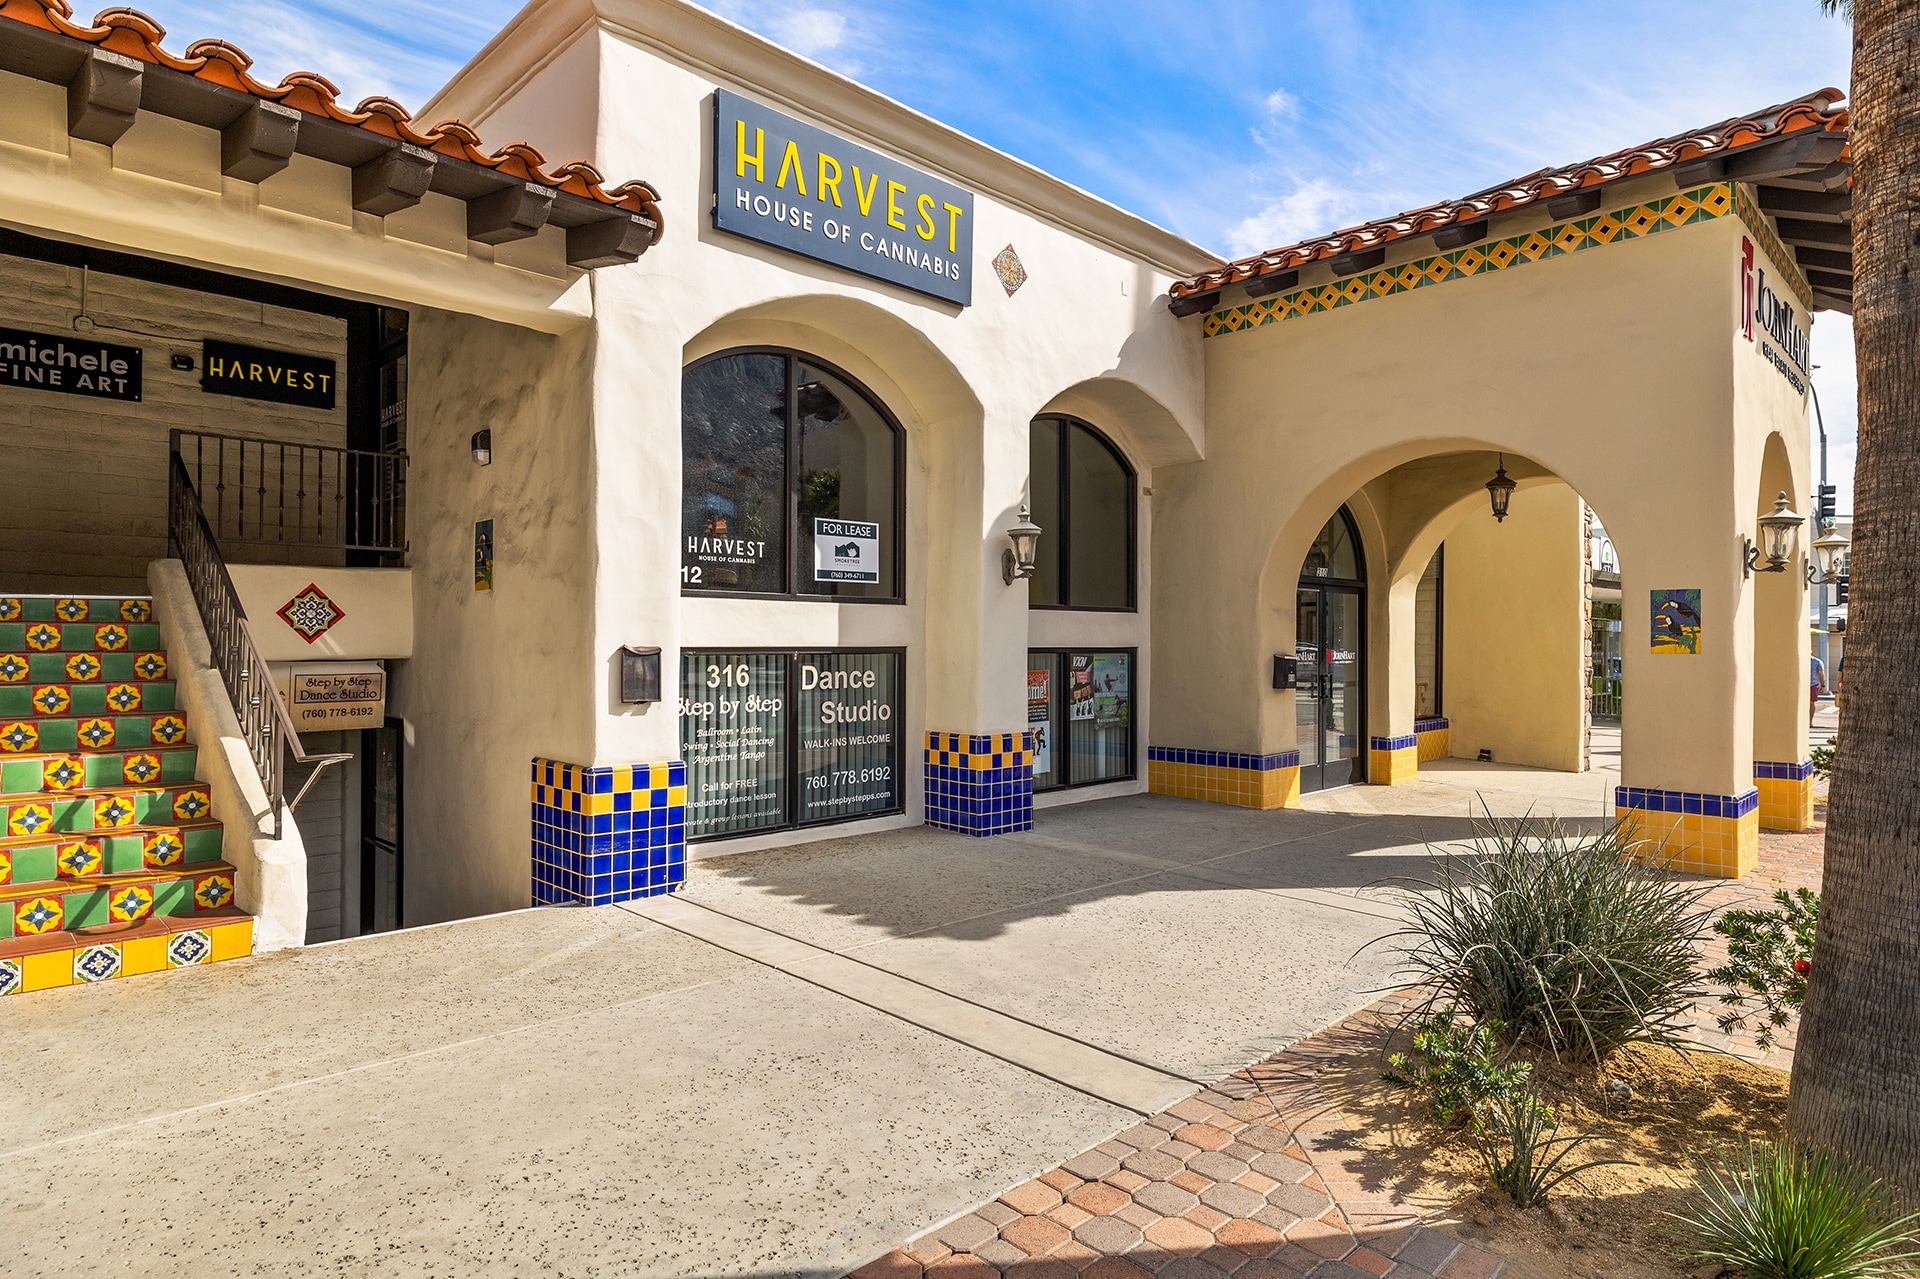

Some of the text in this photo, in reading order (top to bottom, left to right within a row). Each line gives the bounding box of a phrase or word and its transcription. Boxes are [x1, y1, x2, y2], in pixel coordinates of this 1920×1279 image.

[735, 119, 962, 253] HARVEST
[735, 187, 960, 281] HOUSE OF CANNABIS
[0, 339, 129, 375] michele
[76, 373, 128, 394] ART
[208, 356, 331, 394] HARVEST
[823, 523, 872, 537] FOR LEASE
[688, 536, 766, 558] HARVEST
[306, 677, 372, 689] Step by Step
[706, 664, 750, 689] 316
[801, 665, 876, 691] Dance
[300, 690, 337, 701] Dance
[339, 688, 377, 700] Studio
[302, 707, 373, 720] (760) 778-6192
[719, 695, 740, 720] by
[745, 694, 782, 717] Step
[820, 700, 892, 724] Studio
[696, 725, 763, 738] Ballroom Latin
[682, 737, 775, 753] Swing Social Dancing
[804, 734, 891, 749] WALK-INS WELCOME
[692, 750, 767, 767] Argentine Tango
[701, 778, 758, 793] Call for FREE
[686, 791, 777, 809] troductory dance lesson
[807, 791, 891, 808] www.stepbystepps.com
